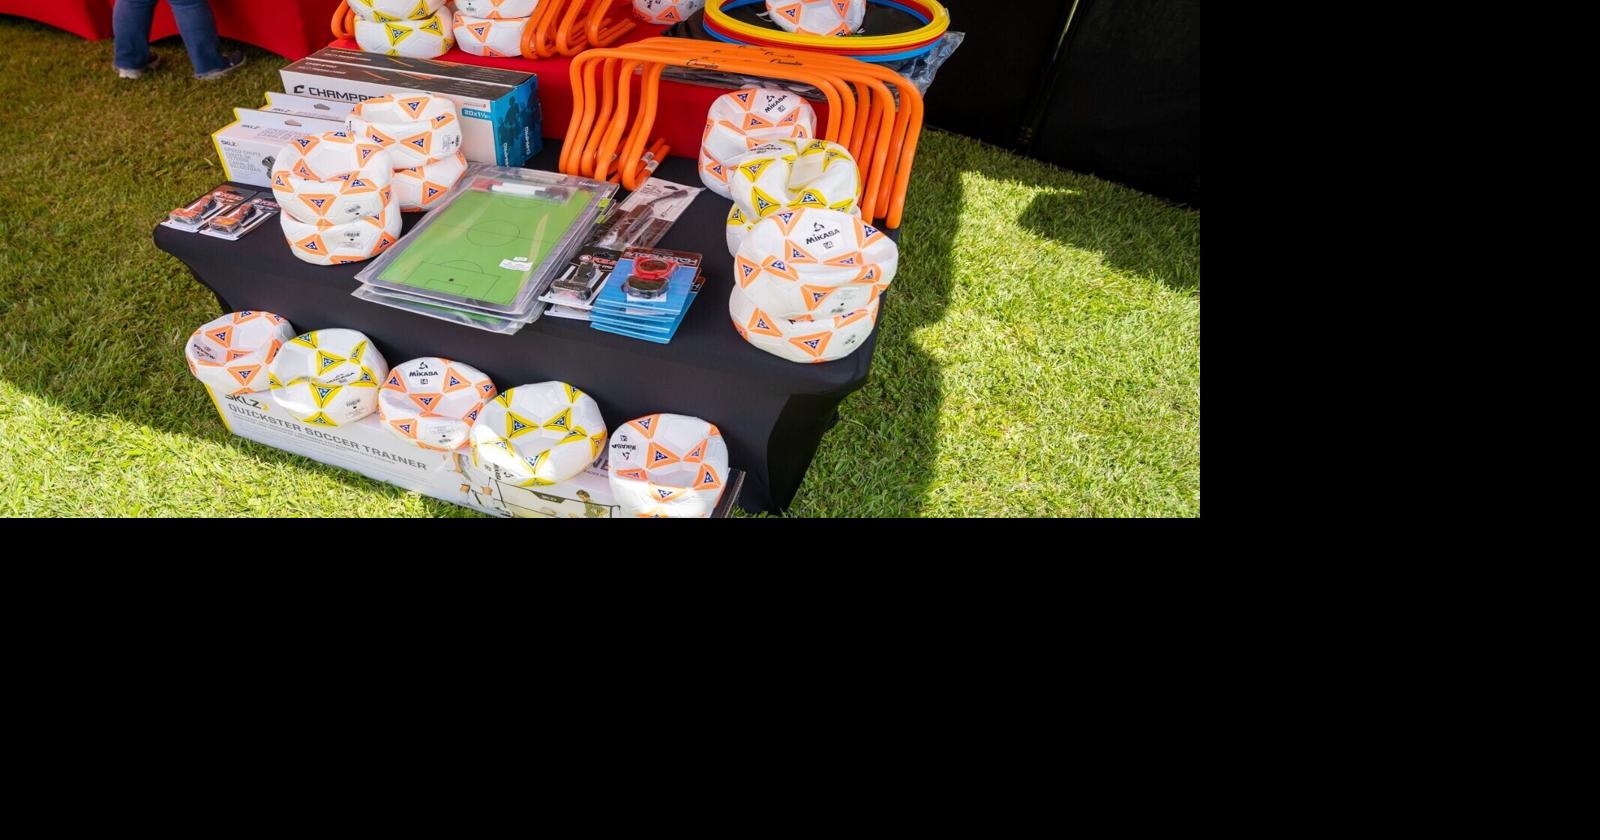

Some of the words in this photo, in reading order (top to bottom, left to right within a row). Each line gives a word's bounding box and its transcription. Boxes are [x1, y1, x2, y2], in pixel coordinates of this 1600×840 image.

[308, 87, 385, 102] CHAMPR
[805, 228, 841, 245] MiKASA
[224, 393, 262, 410] SKLZ
[228, 403, 302, 432] QUICKSTER
[304, 427, 360, 450] SOCCER
[362, 444, 428, 471] TRAINER
